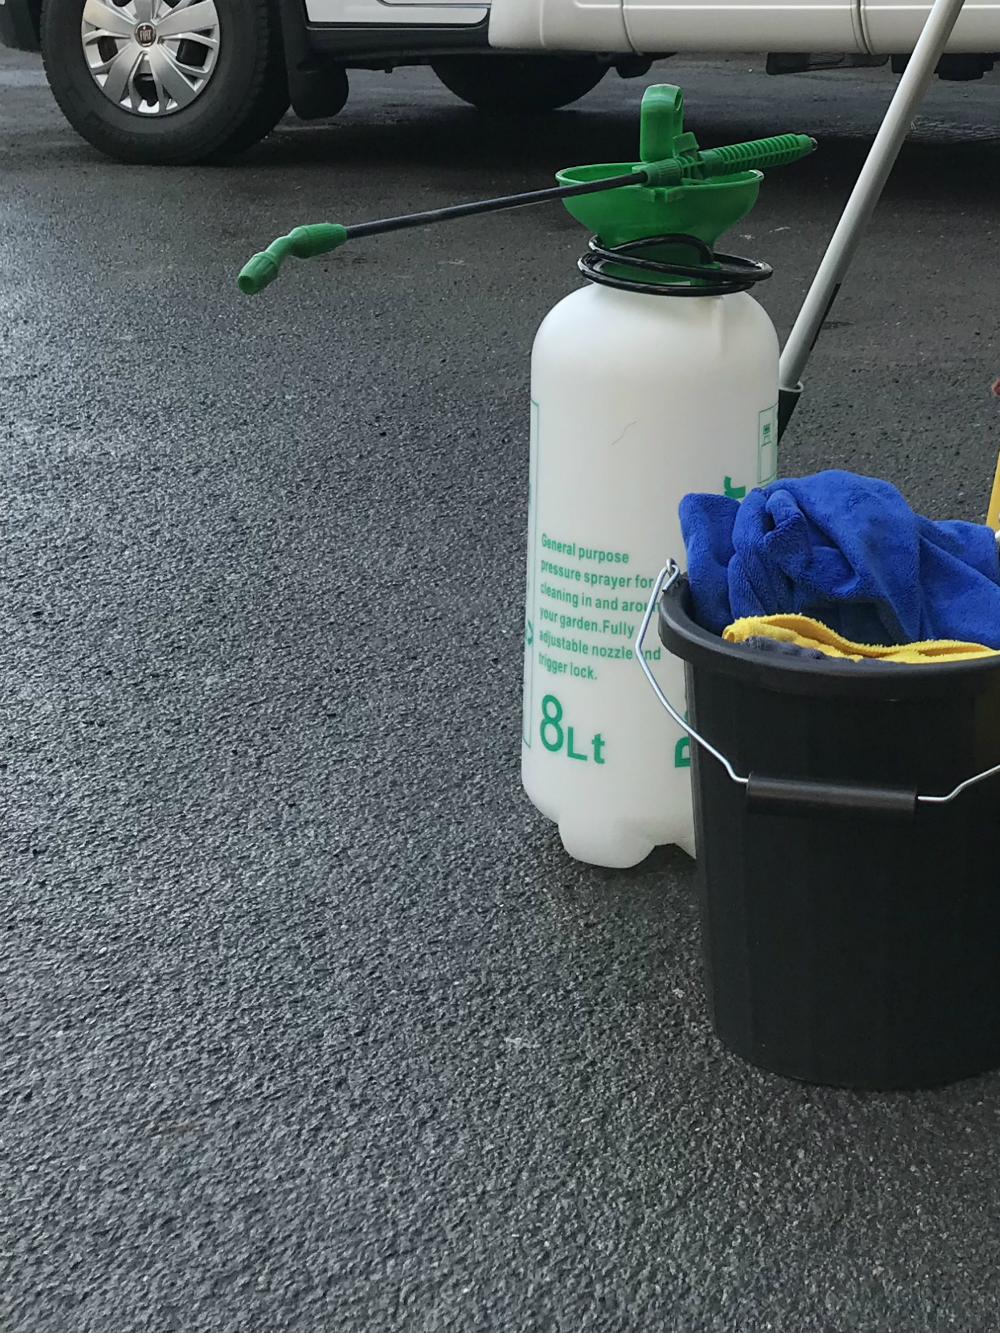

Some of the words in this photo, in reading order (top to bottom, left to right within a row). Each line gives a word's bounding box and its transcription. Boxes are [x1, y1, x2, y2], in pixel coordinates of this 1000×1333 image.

[541, 533, 576, 556] General
[578, 547, 629, 564] purpose
[541, 560, 581, 582] pressure
[584, 572, 632, 590] sprayer
[635, 574, 654, 588] for
[540, 582, 578, 608] cleaning
[582, 592, 592, 607] in
[595, 597, 618, 610] and
[540, 607, 558, 622] your
[539, 630, 589, 654] adjustable
[592, 645, 633, 660] nozzle
[643, 647, 661, 660] nd
[538, 651, 568, 674] trigger
[570, 662, 597, 680] lock.
